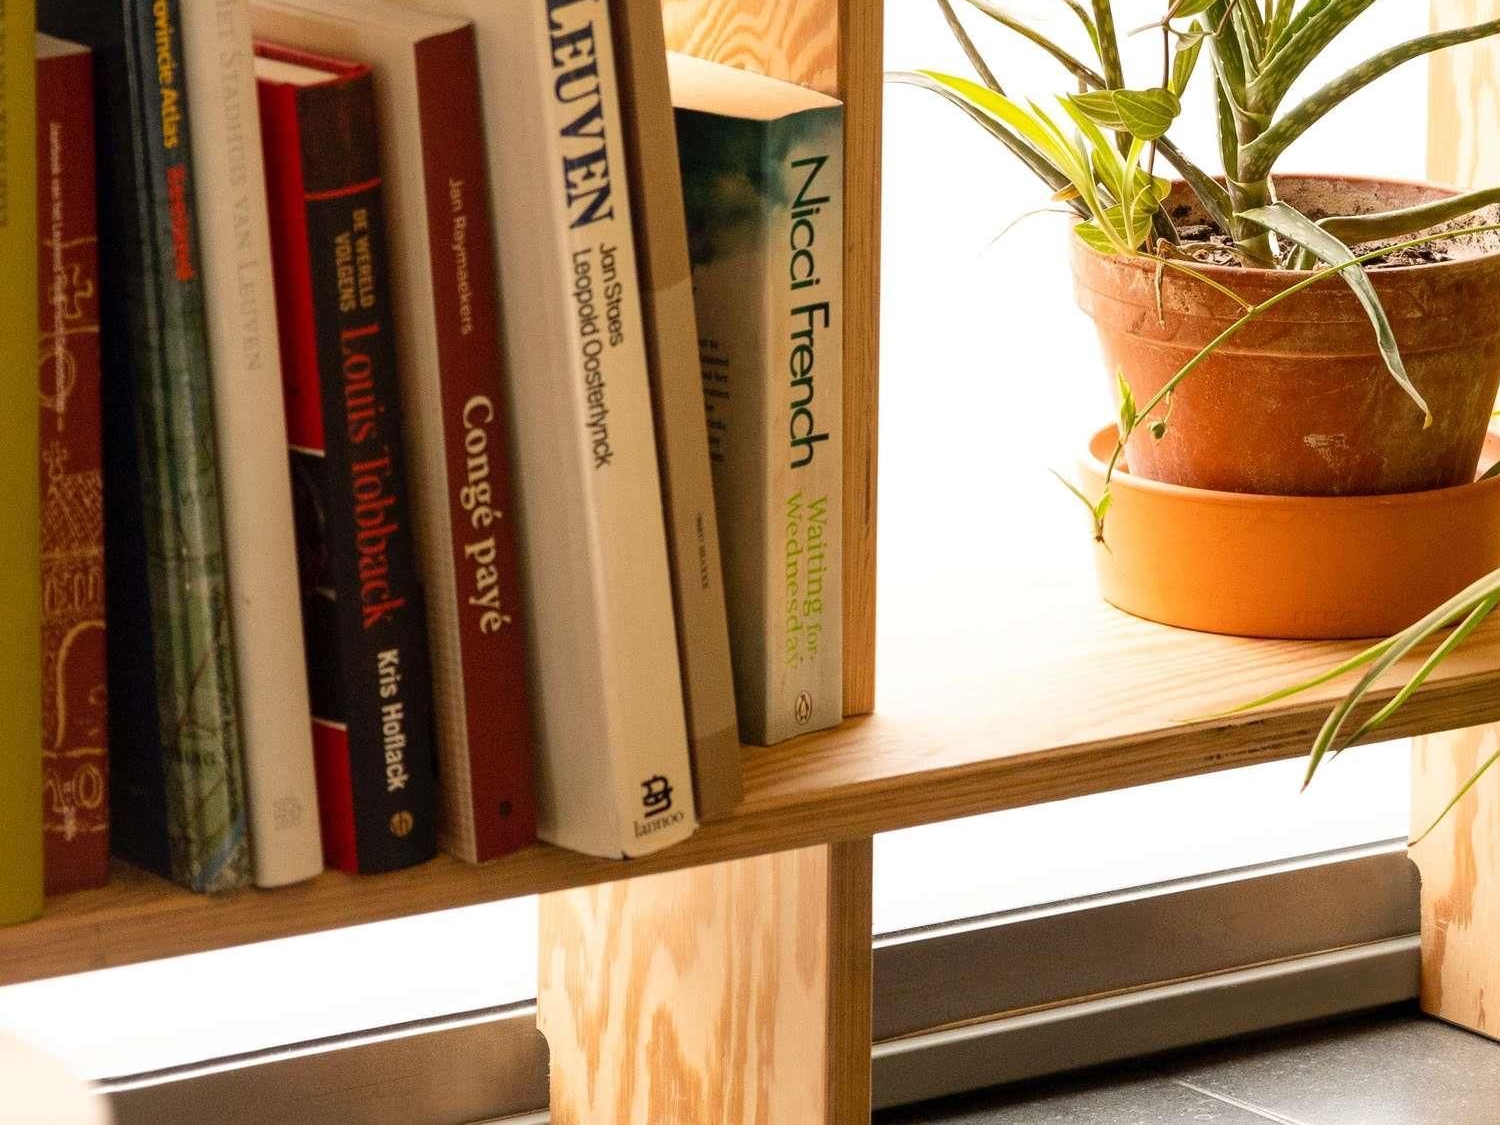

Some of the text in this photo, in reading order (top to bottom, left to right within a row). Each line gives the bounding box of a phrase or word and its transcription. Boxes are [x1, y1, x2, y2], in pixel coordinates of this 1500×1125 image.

[159, 88, 181, 149] Atlas
[334, 231, 358, 313] VOLGENS
[352, 208, 376, 308] DE WERELD
[449, 177, 473, 336] Jan Raymaekers
[600, 242, 624, 347] Jan Staes
[789, 155, 830, 470] Nicci French
[573, 247, 614, 469] Leopold Oosterlynck
[340, 322, 408, 630] Louis Tobback
[460, 395, 512, 635] Congé payé
[784, 491, 804, 668] Wednesday
[803, 494, 828, 653] Waiting for
[377, 648, 410, 793] Kris Hoflack
